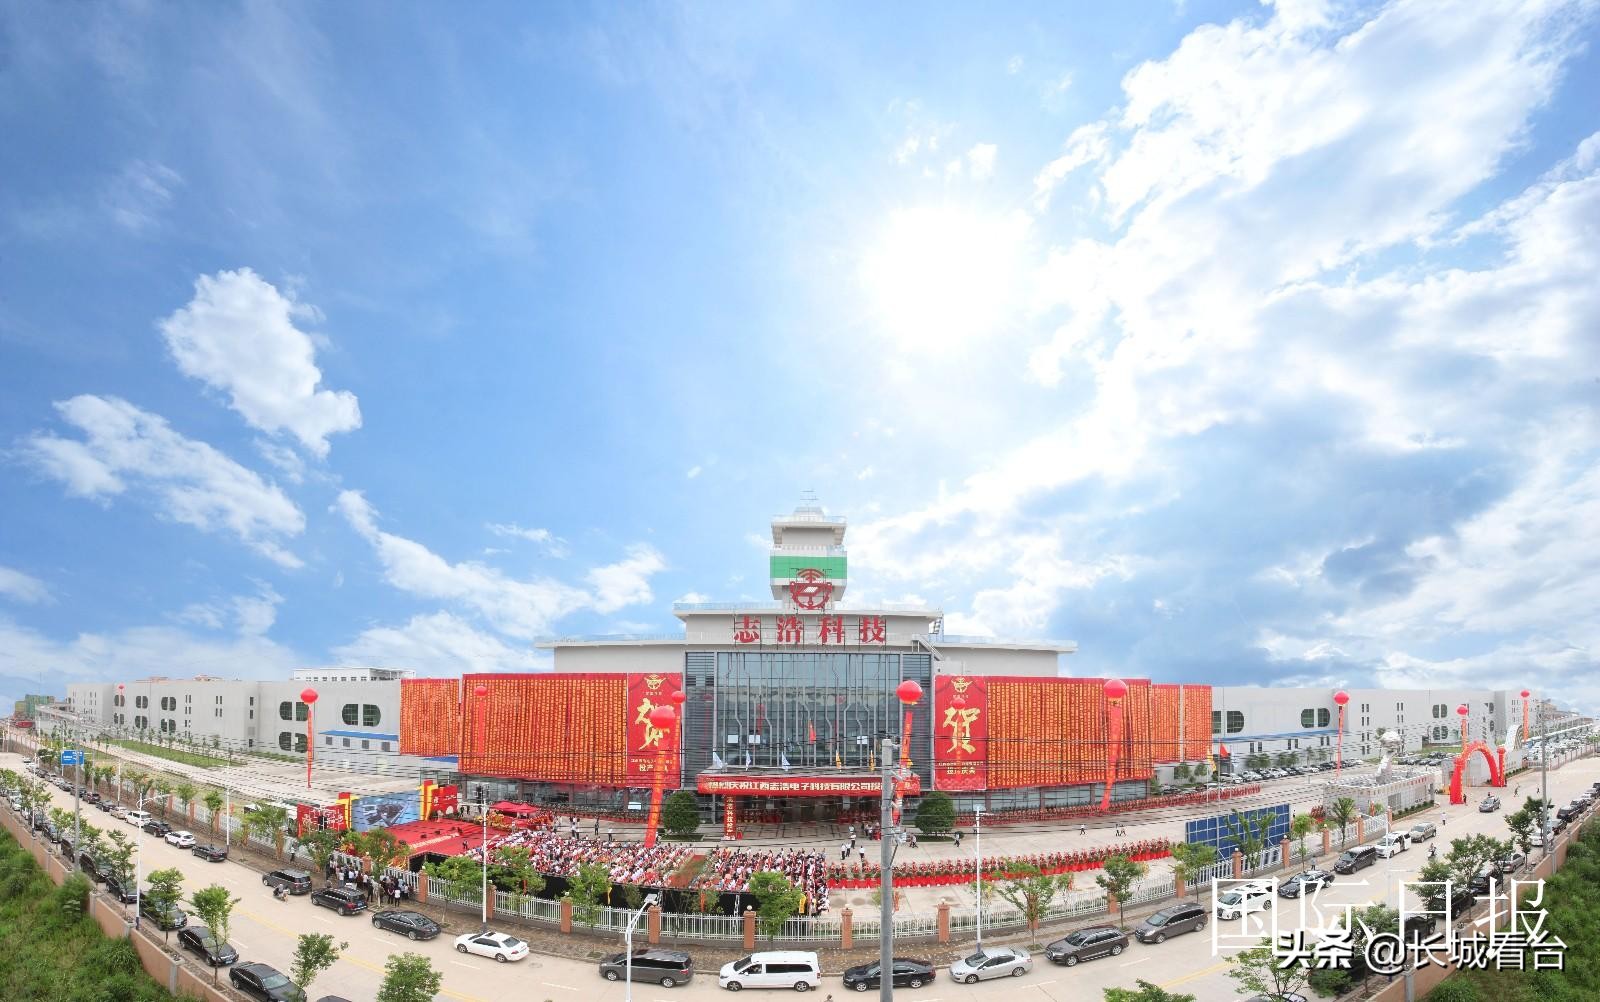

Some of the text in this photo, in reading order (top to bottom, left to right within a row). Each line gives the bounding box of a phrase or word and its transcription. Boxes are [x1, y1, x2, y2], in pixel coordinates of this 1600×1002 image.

[733, 615, 887, 644] 志浩科技
[942, 706, 981, 755] 贺
[707, 780, 911, 792] 热烈庆祝江西志浩电子科技有限公司投
